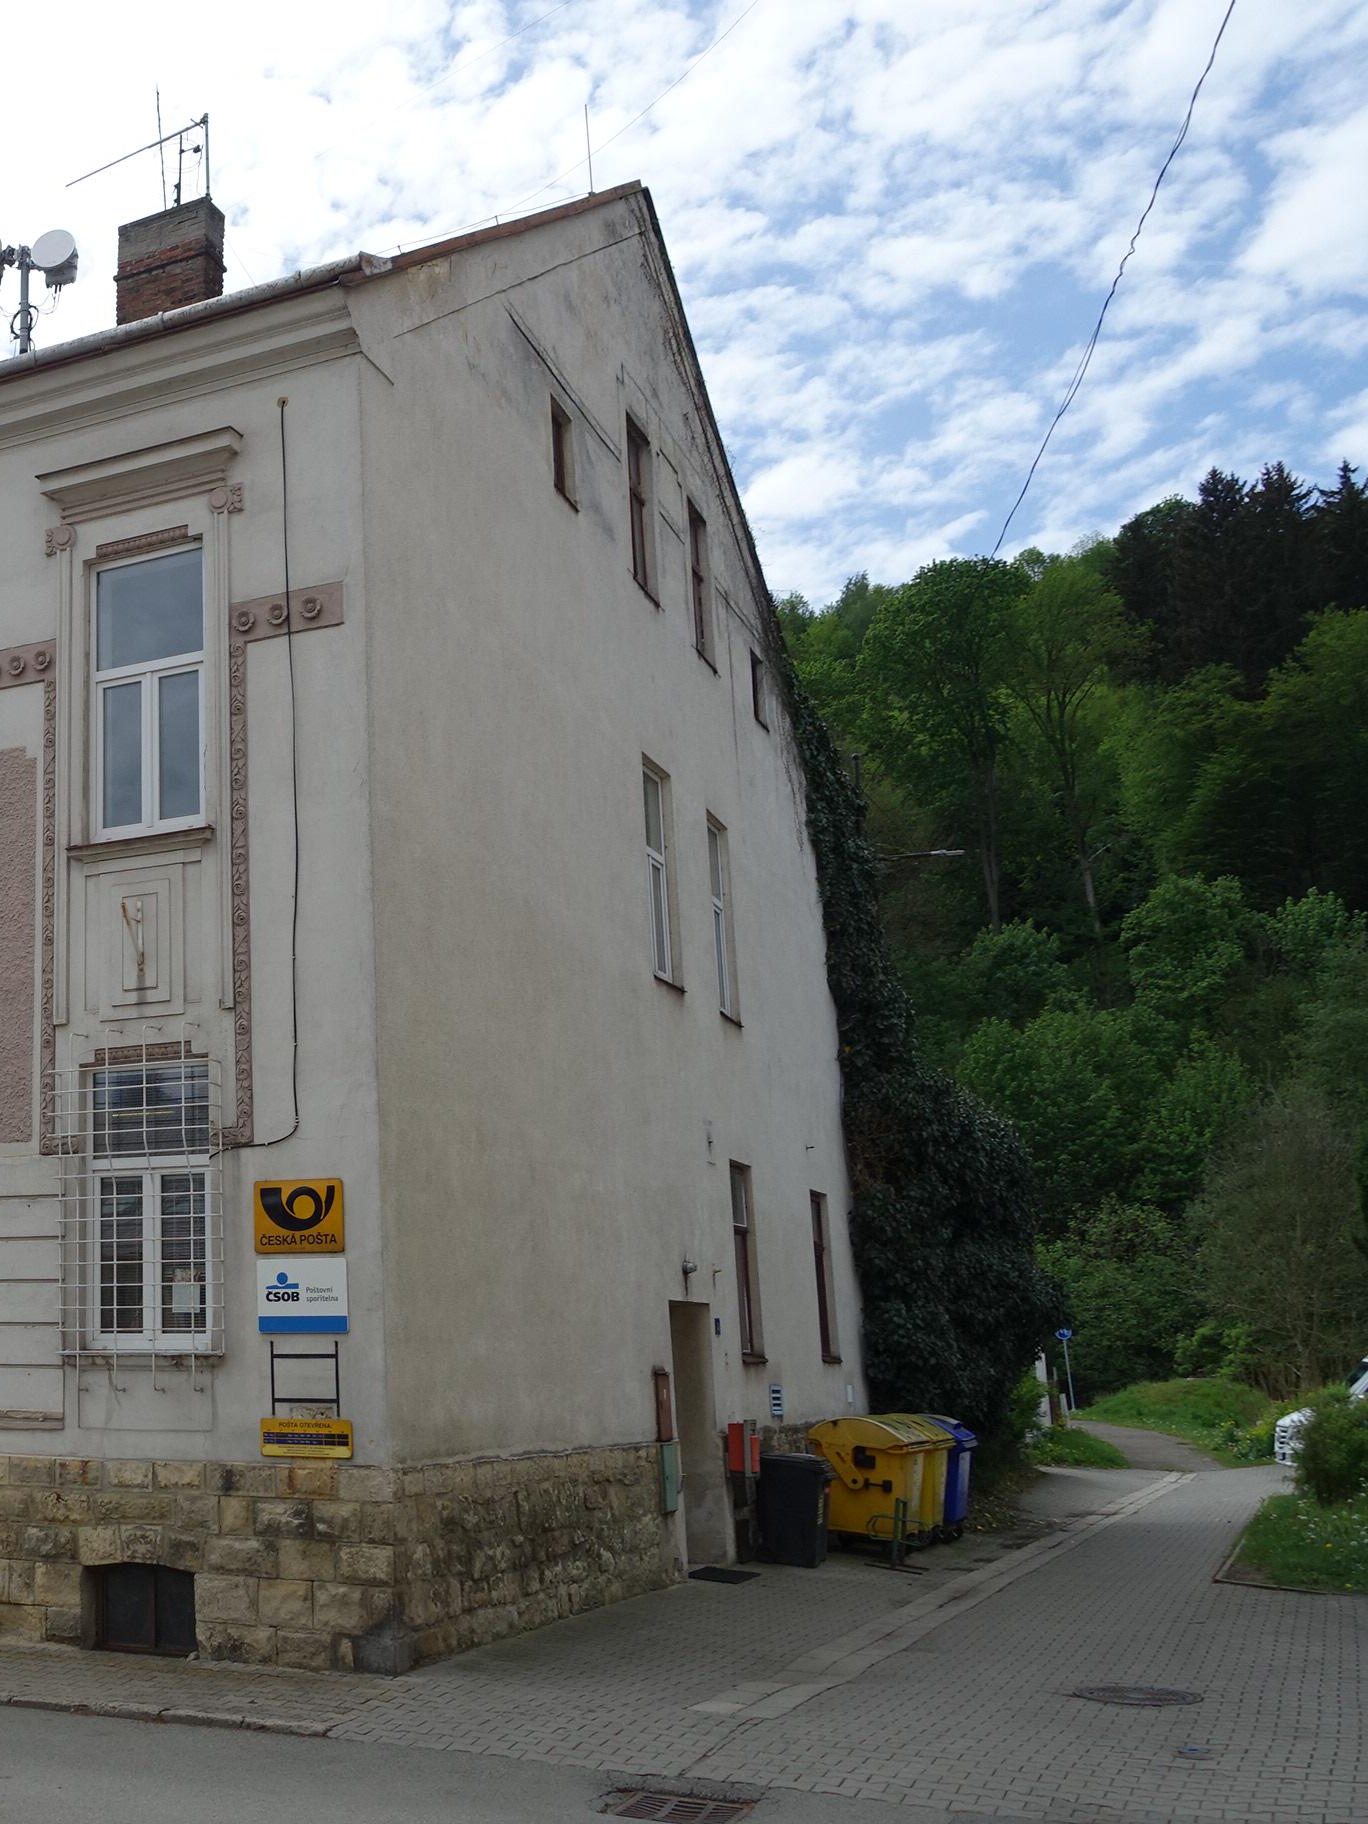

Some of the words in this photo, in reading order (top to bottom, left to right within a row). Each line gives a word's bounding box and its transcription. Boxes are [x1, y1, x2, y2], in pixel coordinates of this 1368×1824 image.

[260, 1232, 297, 1246] ČESKÁ
[299, 1232, 337, 1245] POŠTA
[265, 1291, 300, 1302] ČSOB
[306, 1295, 339, 1303] spořitelna
